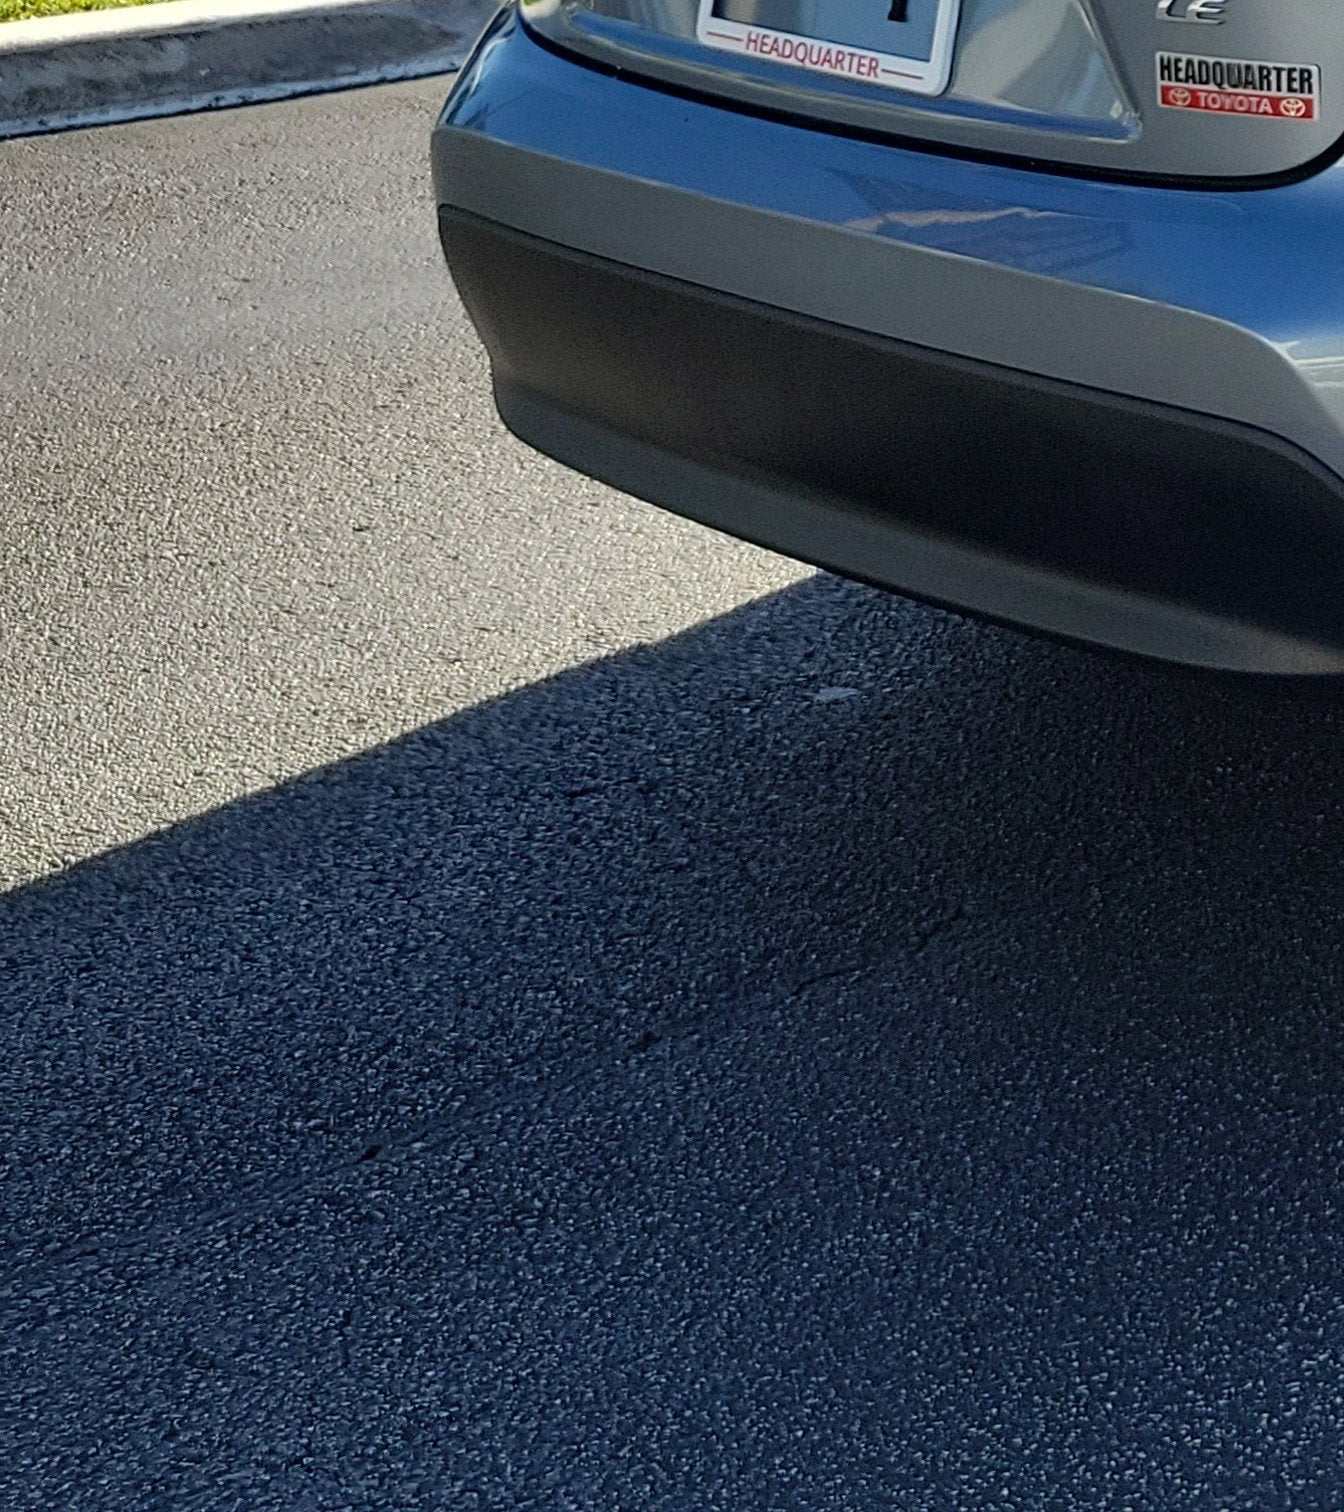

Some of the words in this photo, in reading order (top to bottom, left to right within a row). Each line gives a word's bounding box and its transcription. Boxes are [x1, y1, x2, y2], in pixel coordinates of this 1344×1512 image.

[745, 31, 880, 78] HEADQUARTER
[1160, 55, 1314, 94] HEADQUARTER
[1197, 92, 1273, 115] TOYOTA
